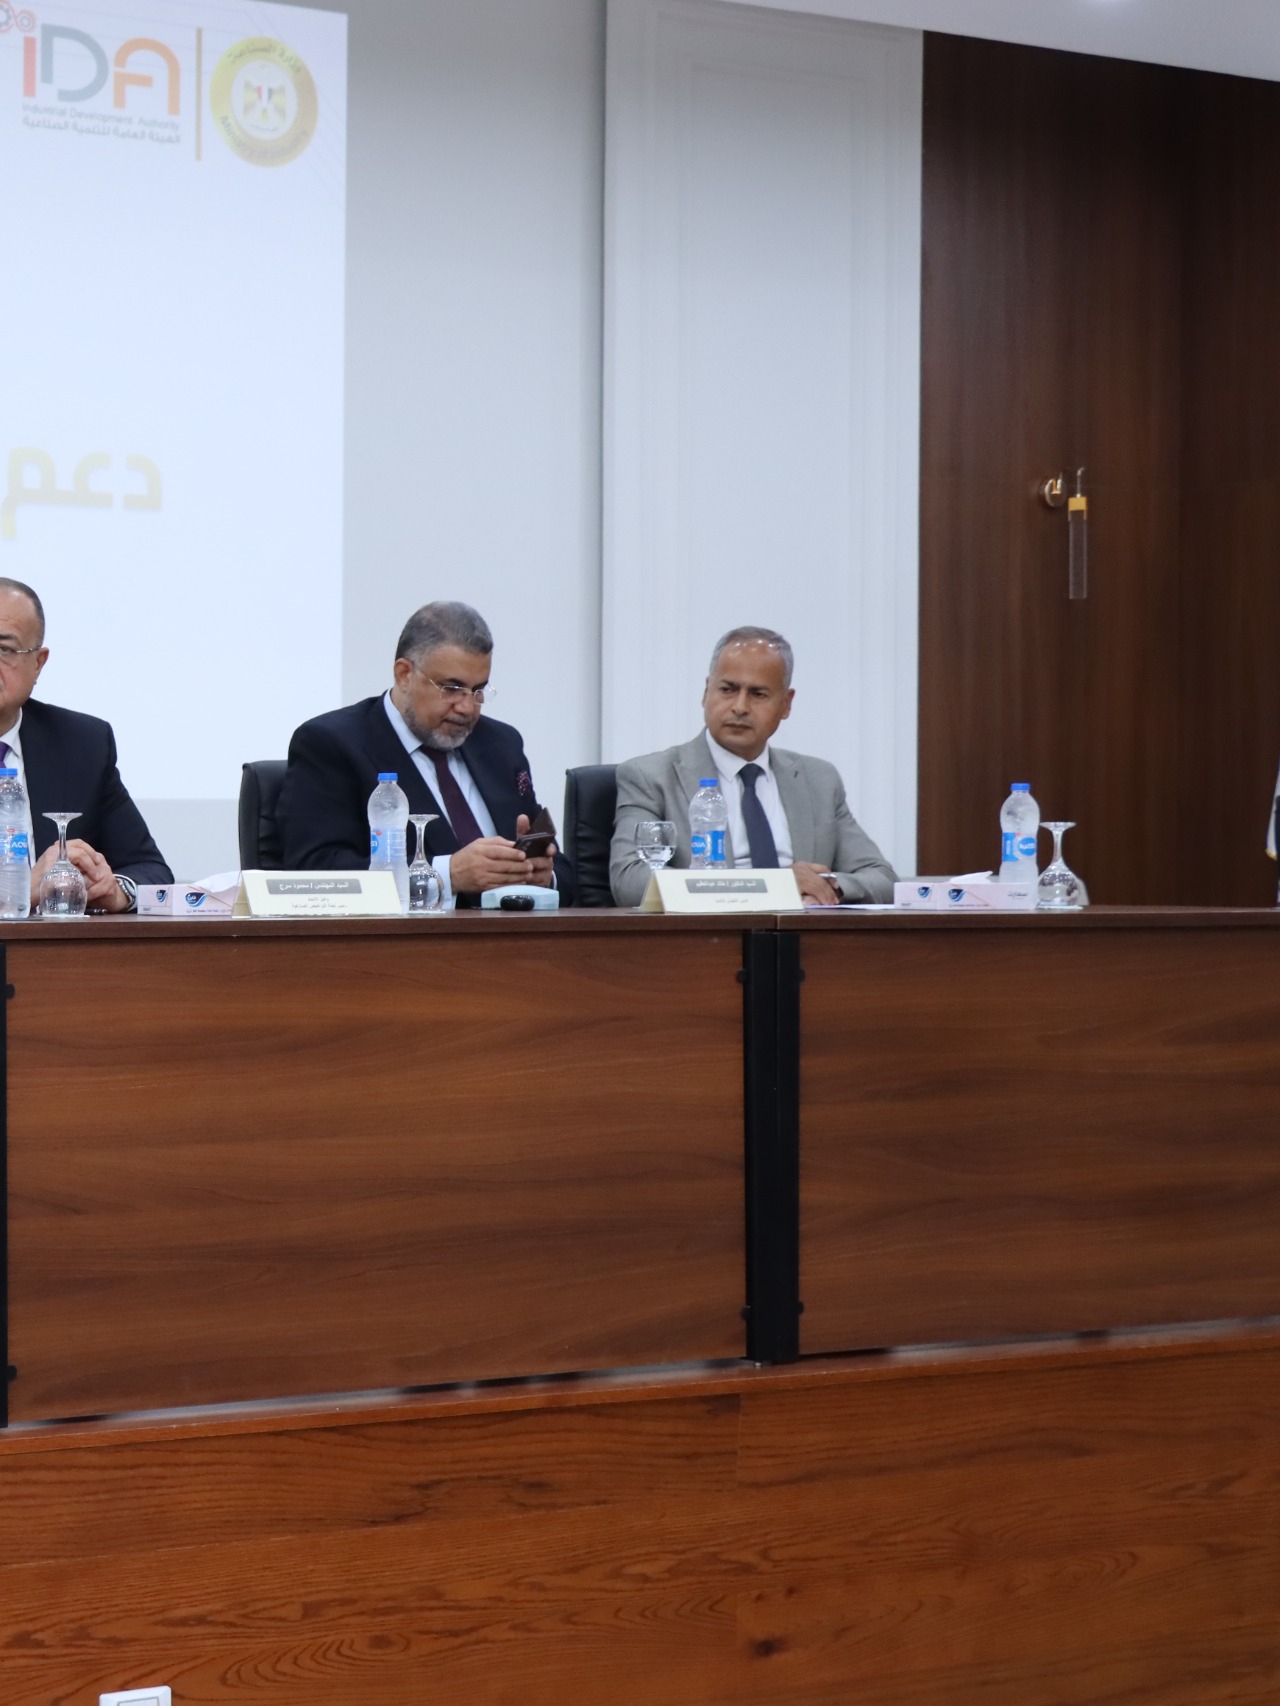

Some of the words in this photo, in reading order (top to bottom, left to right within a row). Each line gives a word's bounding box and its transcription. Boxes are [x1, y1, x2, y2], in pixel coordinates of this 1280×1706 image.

[22, 103, 67, 117] Industrial
[69, 107, 133, 125] Development
[138, 116, 180, 131] Authority
[22, 115, 69, 130] الصناعية
[71, 121, 110, 136] للتنمية
[112, 126, 145, 140] العامة
[148, 131, 181, 145] الهيئة
[0, 441, 163, 540] دعم
